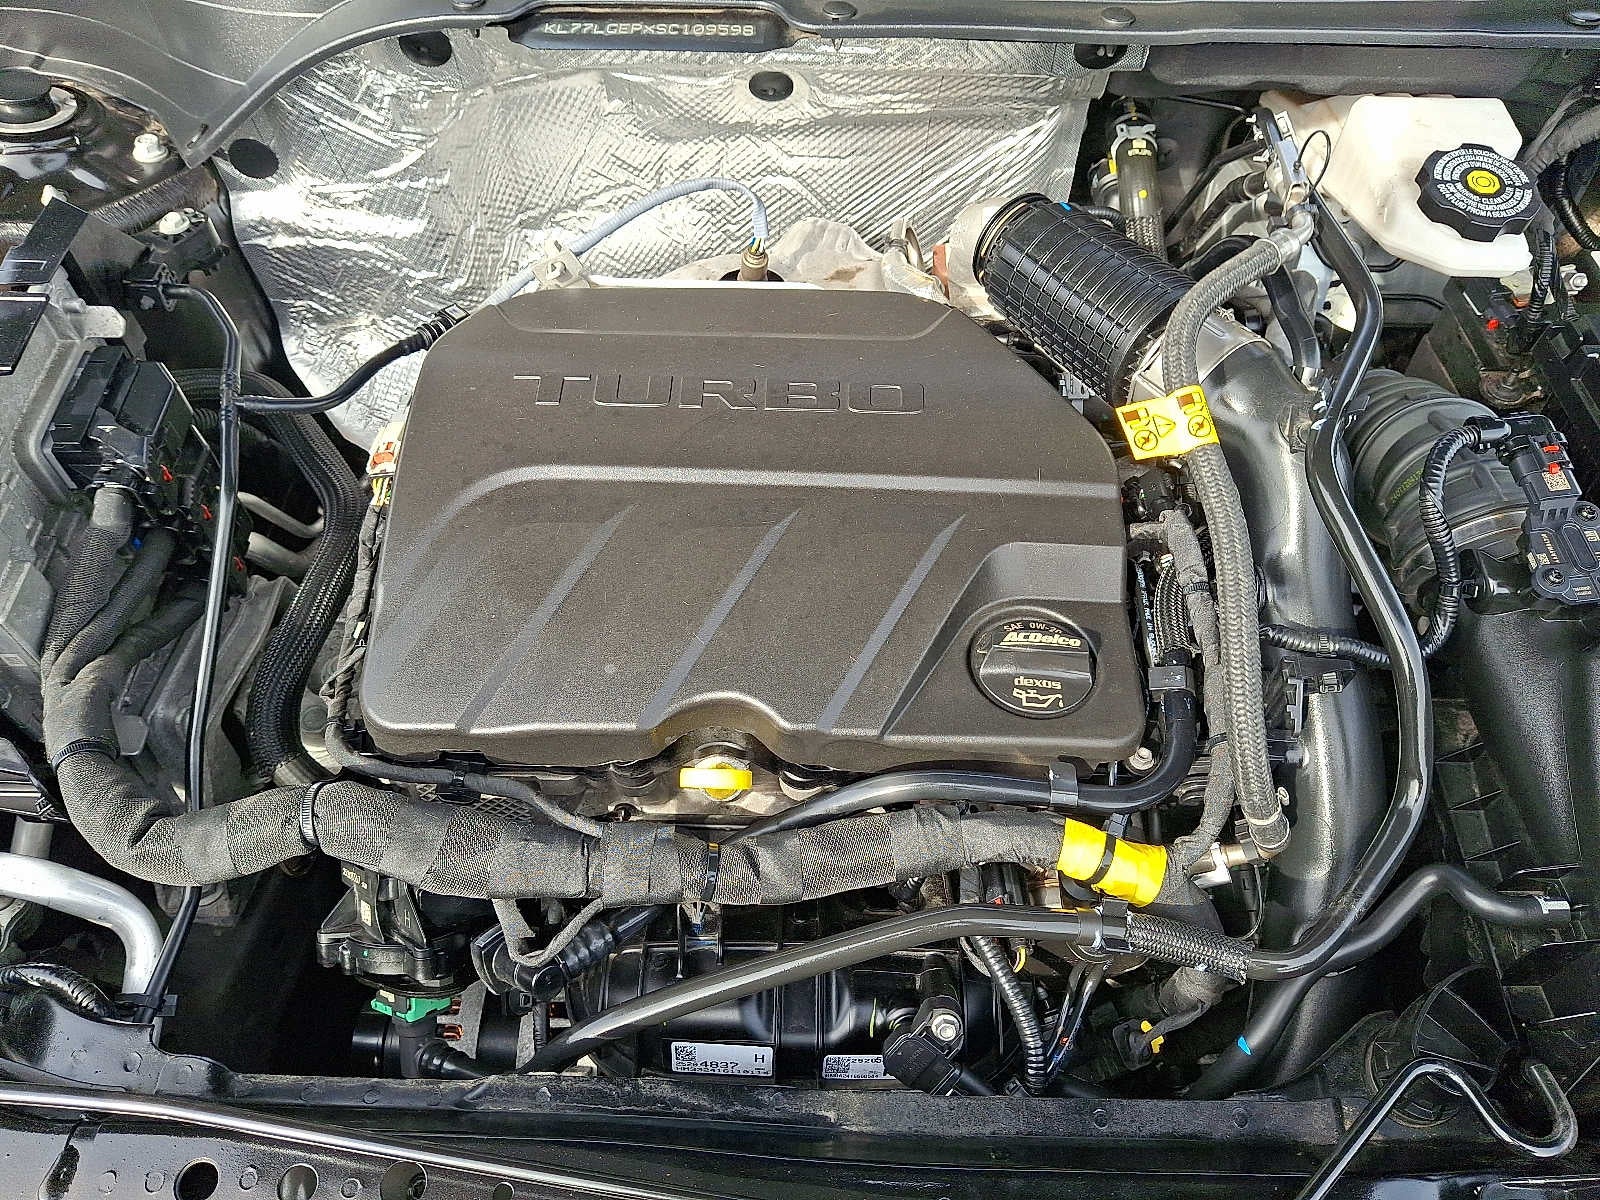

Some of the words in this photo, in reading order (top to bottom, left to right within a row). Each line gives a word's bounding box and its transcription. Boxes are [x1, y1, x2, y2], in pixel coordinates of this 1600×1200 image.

[1446, 195, 1467, 209] FLUID
[1465, 205, 1486, 216] FROM
[513, 373, 925, 415] TURBO
[1003, 623, 1024, 632] SAE
[1000, 631, 1081, 648] ACDelco
[1014, 676, 1062, 689] dexos
[754, 1053, 765, 1064] H
